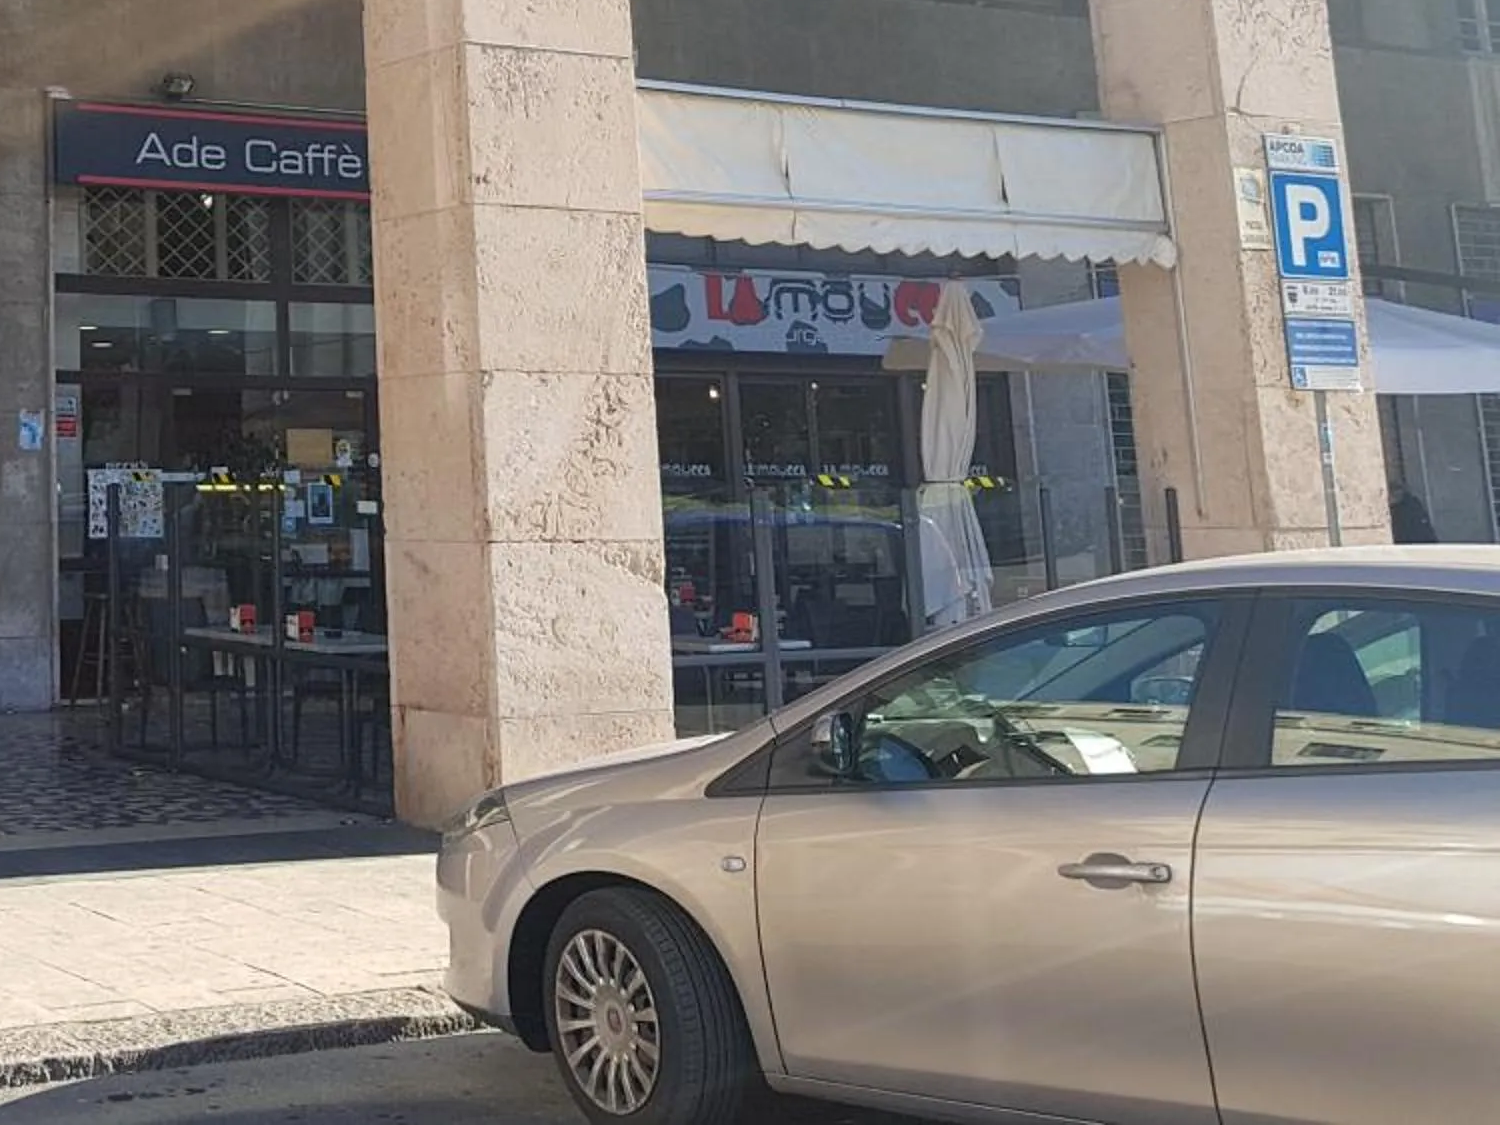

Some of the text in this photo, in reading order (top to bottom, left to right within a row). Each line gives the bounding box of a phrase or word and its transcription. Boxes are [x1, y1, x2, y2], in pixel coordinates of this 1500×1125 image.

[135, 132, 363, 178] Ade Caffè
[1285, 183, 1331, 267] P
[704, 274, 767, 326] LA
